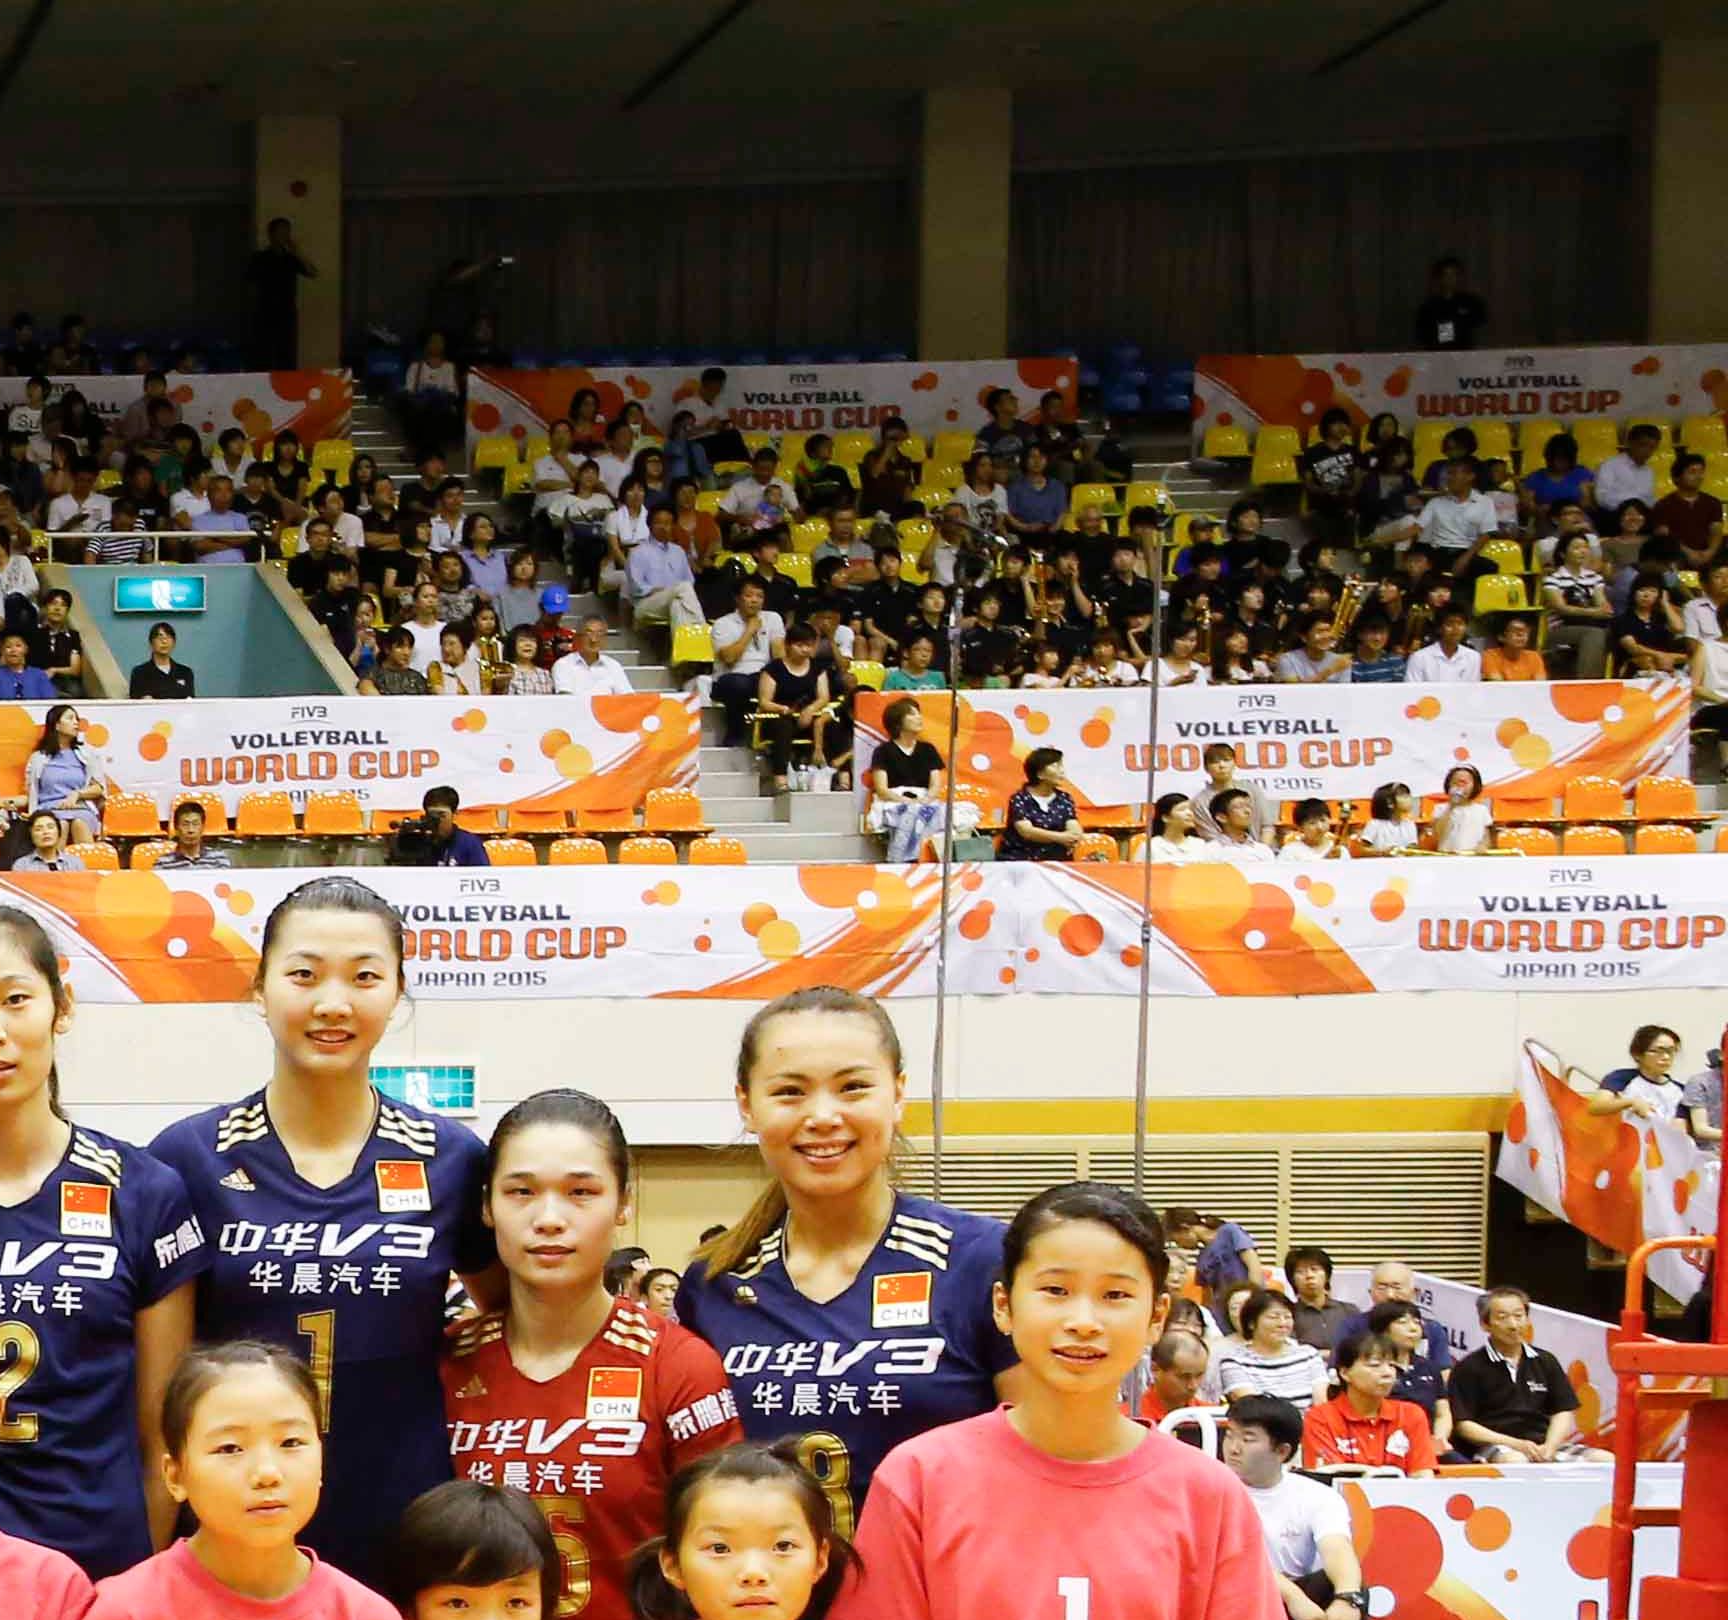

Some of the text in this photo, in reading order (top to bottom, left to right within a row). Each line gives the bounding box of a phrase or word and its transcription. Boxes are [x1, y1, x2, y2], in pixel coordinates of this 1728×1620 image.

[1458, 375, 1582, 390] VOLLEYBALL
[744, 391, 864, 405] VOLLEYBALL
[1416, 389, 1622, 418] WORLD CUP
[1238, 695, 1276, 708] FIVB
[291, 706, 328, 718] FIVB
[1175, 718, 1339, 737] VOLLEYBALL
[231, 730, 389, 750] VOLLEYBALL
[1123, 737, 1394, 772] WOLD CUP
[179, 749, 440, 787] WORLD CUP
[1273, 777, 1323, 791] 2015
[460, 879, 501, 893] FIVB
[1480, 894, 1668, 913] VOLLEYBALL
[394, 904, 571, 923] VOLLEYBALL
[1418, 914, 1726, 953] WORLD CUP
[403, 926, 626, 962] ORLD CUP
[414, 970, 548, 987] JAPAN 2015
[1499, 961, 1641, 979] JAPAN 2015
[384, 1194, 424, 1208] CHN
[66, 1217, 106, 1231] CHN
[218, 1220, 436, 1259] 中华V3
[249, 1261, 402, 1296] 华晨汽车
[881, 1307, 924, 1323] CHN
[724, 1339, 945, 1378] 中华V3
[296, 1308, 335, 1434] 1
[752, 1380, 902, 1417] 华晨汽车
[593, 1402, 632, 1416] CHN
[467, 1461, 604, 1496] 华晨汽车
